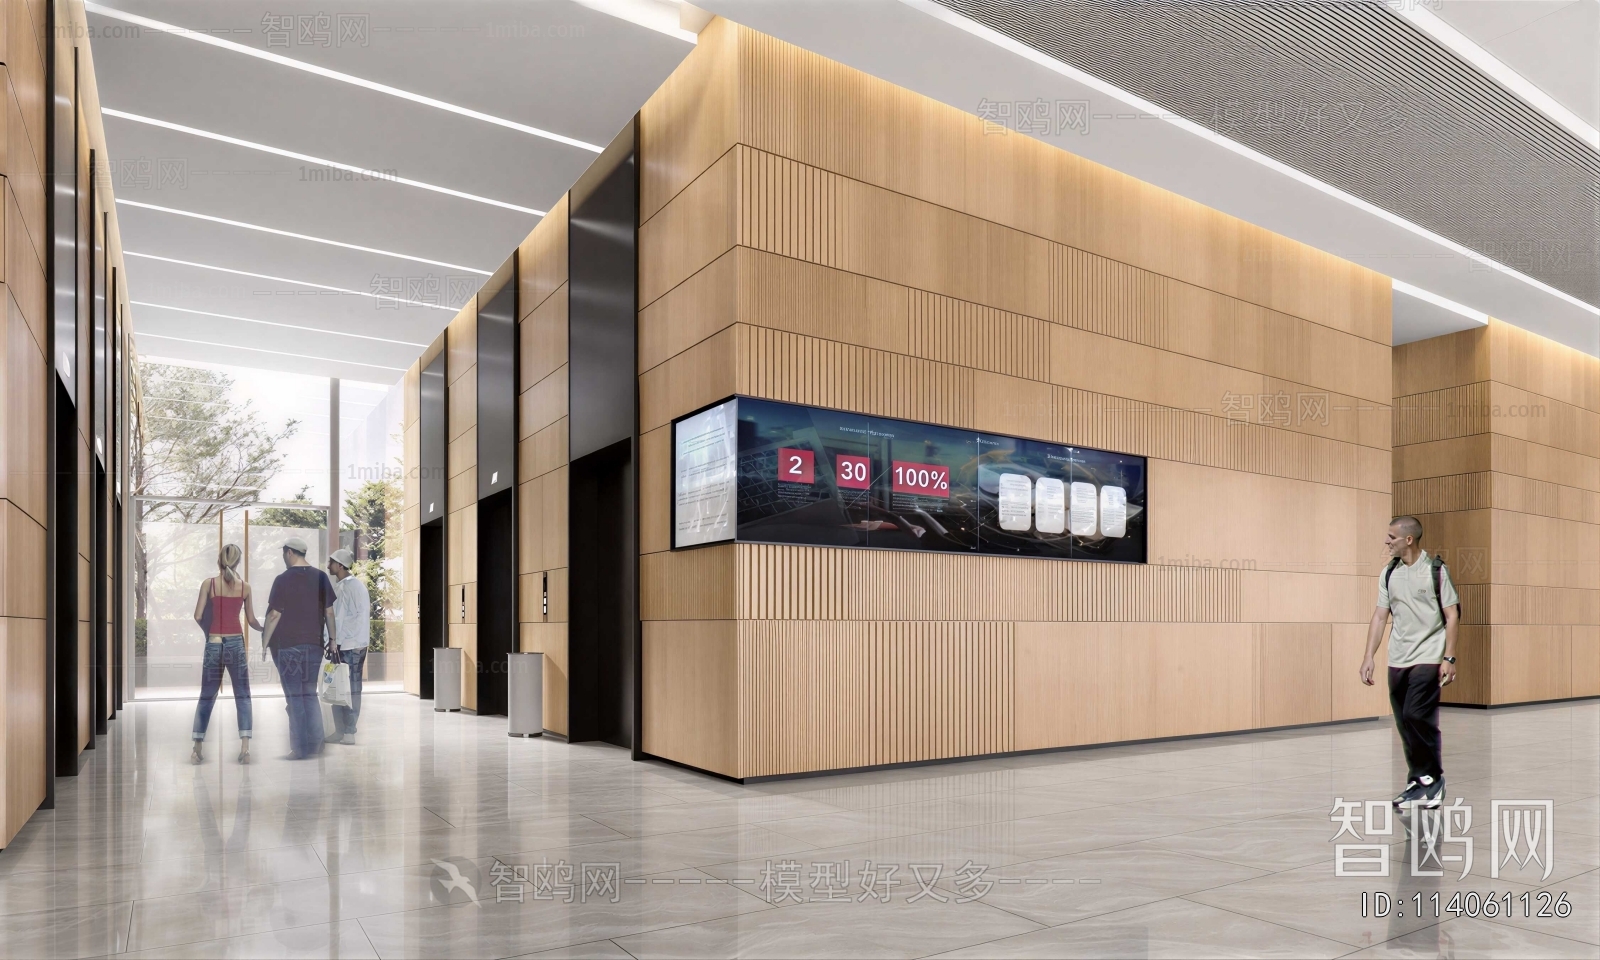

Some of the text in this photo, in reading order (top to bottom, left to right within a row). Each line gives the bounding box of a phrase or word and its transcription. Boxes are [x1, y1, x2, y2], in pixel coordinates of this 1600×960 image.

[789, 455, 803, 475] 2
[840, 461, 867, 482] 30
[895, 466, 948, 490] 100%
